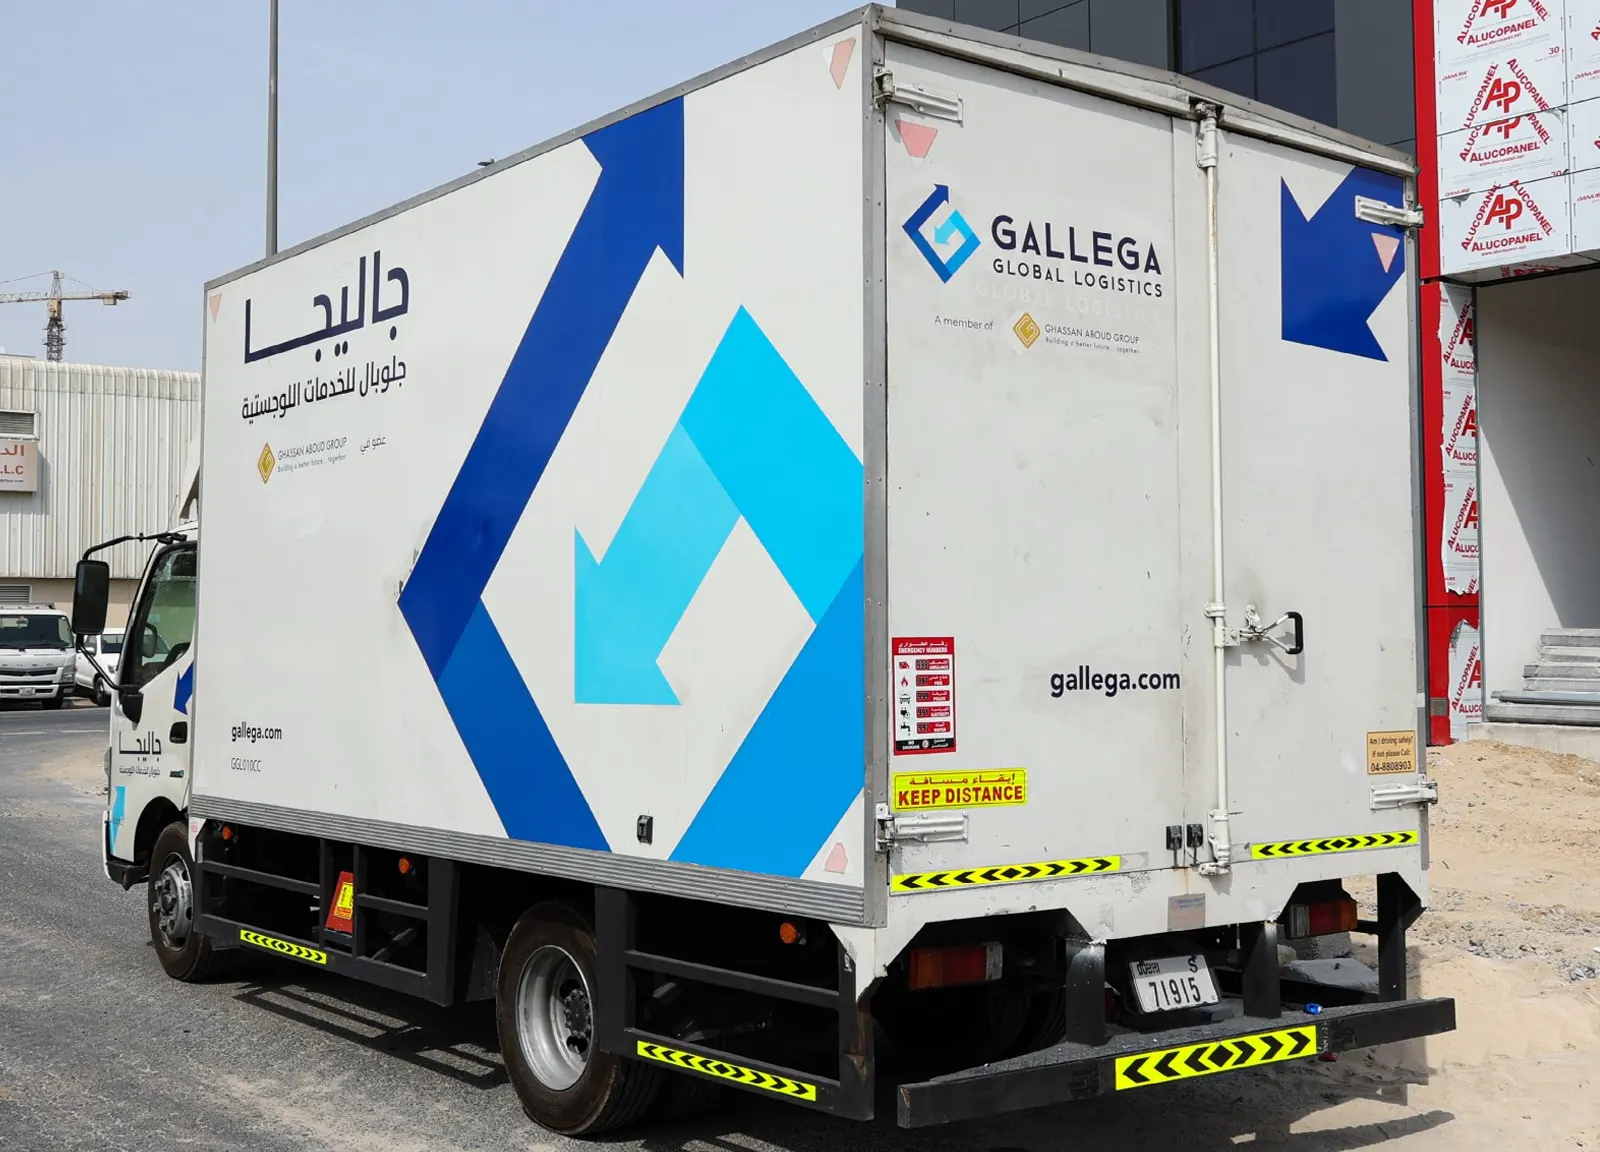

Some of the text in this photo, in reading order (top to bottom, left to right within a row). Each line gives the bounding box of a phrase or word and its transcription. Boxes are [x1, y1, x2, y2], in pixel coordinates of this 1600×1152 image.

[1467, 19, 1538, 45] ALUCOPANEL
[1548, 46, 1560, 55] 30
[1470, 142, 1540, 163] ALUCOPANEL
[1509, 180, 1553, 236] ALUCOPANEL
[991, 214, 1162, 275] GALLEGA
[1471, 232, 1543, 252] ALUCOPANEL
[993, 258, 1163, 298] GLOBAL LOGISTICS
[934, 315, 994, 330] A member of
[1044, 324, 1140, 344] GHASSAN ABOUD GROUP
[1443, 303, 1472, 363] ALUCOPANEL
[242, 355, 407, 425] جلوبال للخدمات اللوجستية
[1445, 394, 1473, 456] ALUCOPANEL
[278, 436, 347, 460] GHASSAN ABOUD GROUP
[1447, 486, 1475, 549] ALUCOPANEL
[1050, 665, 1180, 698] gallega.com
[1451, 645, 1479, 711] ALUCOPANEL
[231, 721, 282, 743] gallega.com
[898, 786, 1023, 806] KEEP DISTANCE
[1188, 956, 1198, 973] S
[1148, 977, 1201, 1007] 71915
